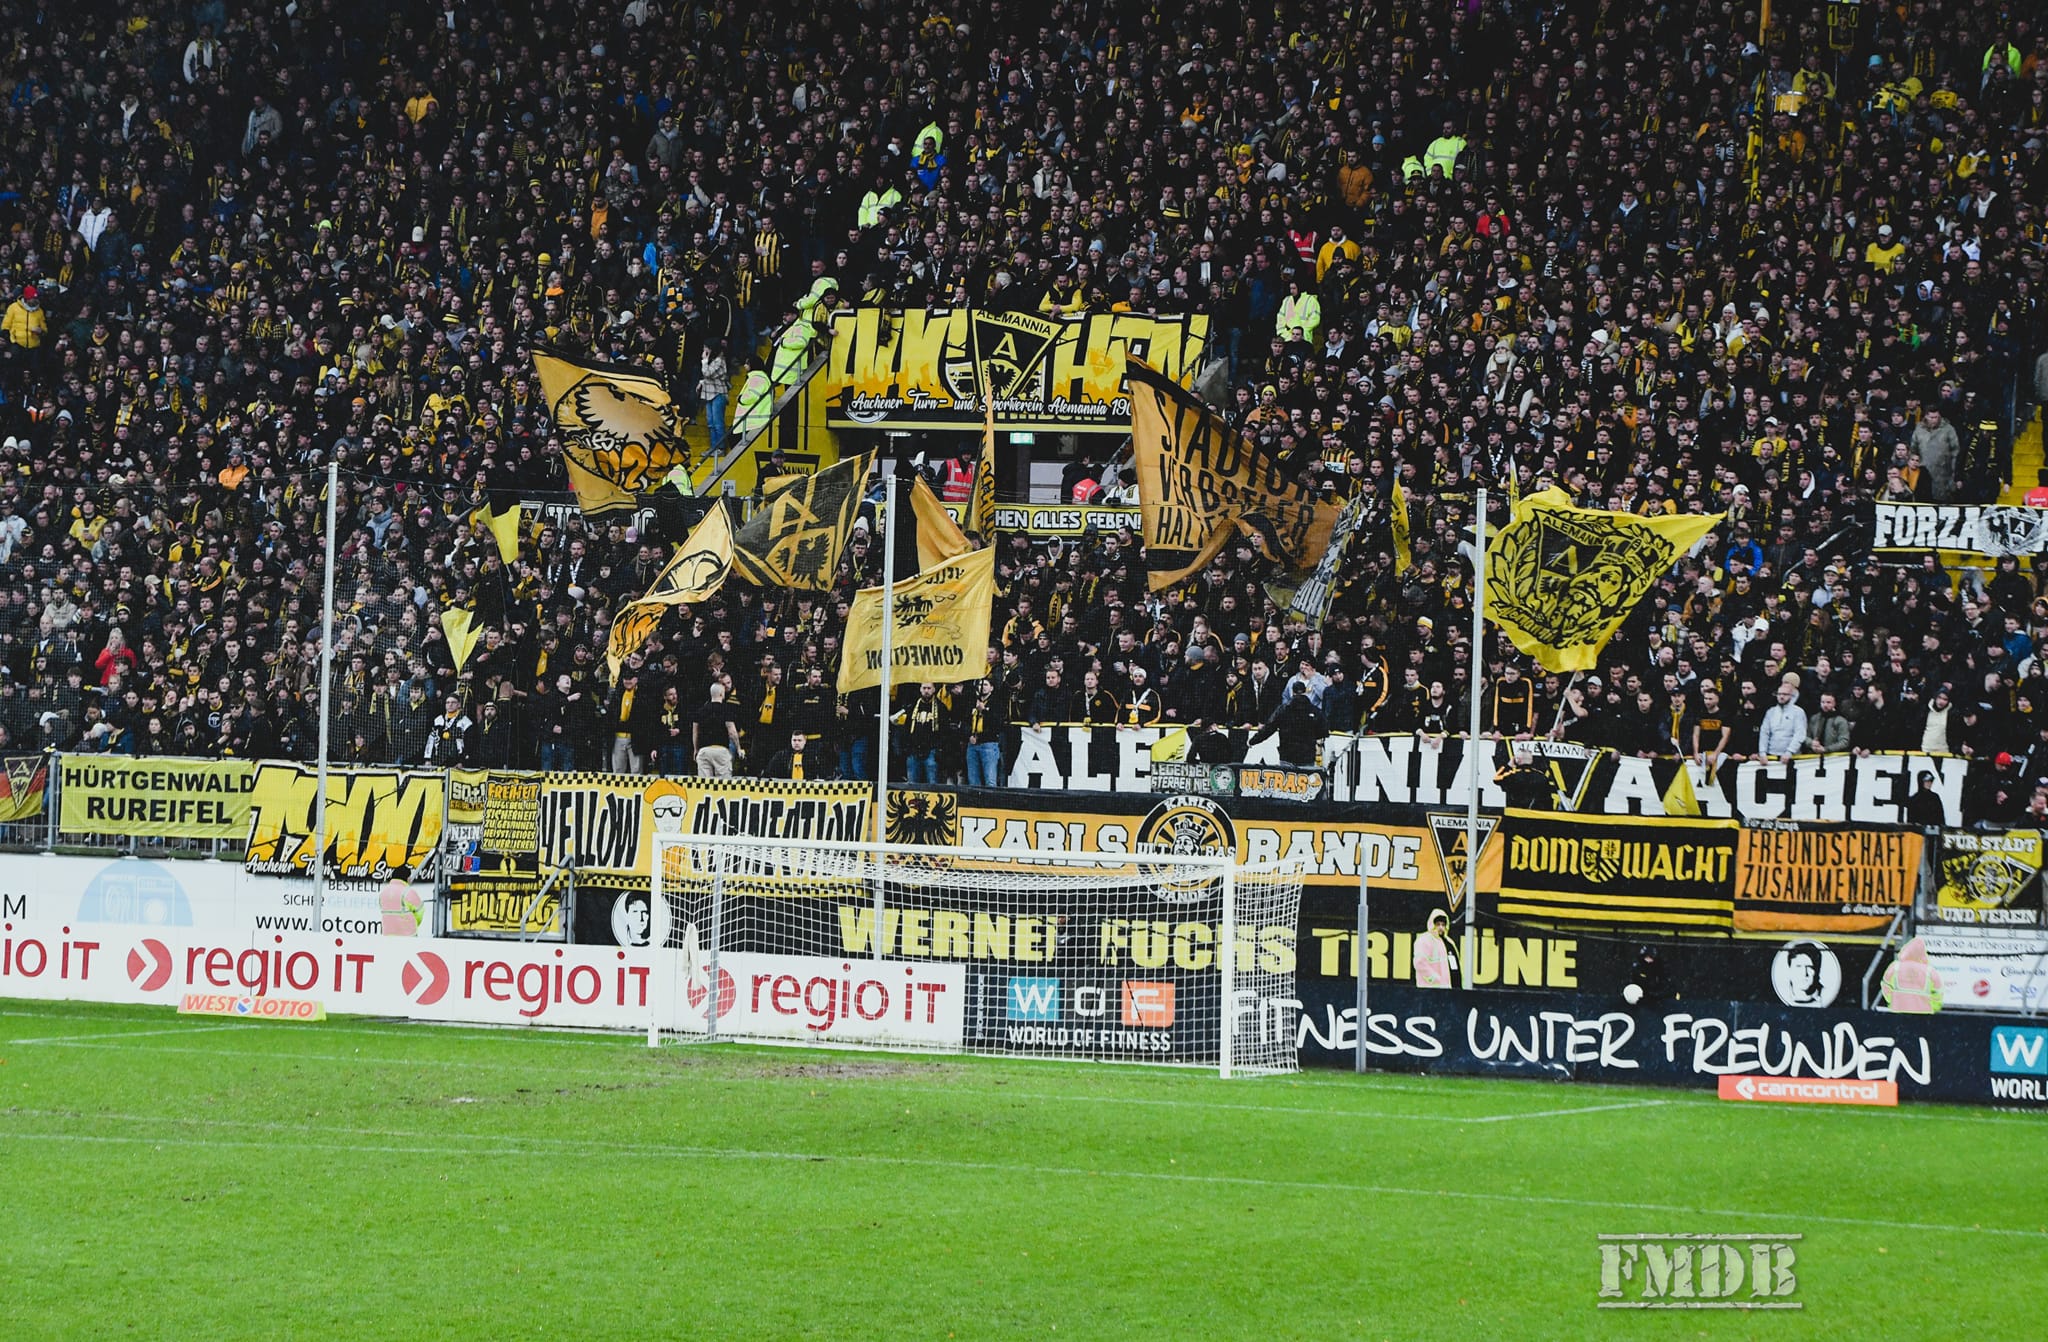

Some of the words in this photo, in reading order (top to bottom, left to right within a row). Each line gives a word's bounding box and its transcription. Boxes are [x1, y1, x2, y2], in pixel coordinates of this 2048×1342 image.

[977, 308, 1051, 336] ALEMANNIA
[993, 332, 1018, 361] A
[851, 391, 903, 410] Aachener
[908, 390, 947, 412] Turn-
[953, 395, 975, 410] und
[1047, 395, 1107, 415] Alemannia
[1033, 511, 1081, 530] ALLES
[1873, 504, 1981, 552] FORZA
[65, 765, 253, 796] HÜRTGENWALD
[1151, 764, 1210, 778] LEGENDEN
[1240, 769, 1309, 793] ULTRAS
[488, 783, 537, 800] FREIHEIT
[1164, 795, 1217, 815] KARLS
[87, 796, 233, 825] RUREIFEL
[485, 809, 537, 821] SICHERHEIT
[451, 825, 480, 840] NEIN
[541, 791, 641, 868] YELLOW
[1943, 829, 1978, 850] FÜR
[1980, 835, 2037, 853] STADT
[958, 816, 1130, 869] KARLS
[1244, 826, 1421, 881] BANDE
[1510, 835, 1578, 874] DOM
[1622, 842, 1732, 883] WACHT
[1749, 830, 1905, 867] FREUNDSCHAFT
[246, 855, 296, 875] Aachener
[348, 860, 369, 878] und
[1742, 864, 1906, 903] ZUSAMMENHALT
[461, 890, 553, 924] HALTUNG
[1941, 906, 1975, 923] UND
[1977, 908, 2038, 925] VEREIN
[255, 915, 383, 934] www.otcom
[186, 934, 320, 997] regio
[1100, 919, 1297, 974] FUCHS
[1312, 927, 1578, 988] TRIÜNE
[464, 948, 602, 1018] regio
[751, 963, 889, 1032] regio
[1008, 1025, 1068, 1047] WORLD
[1073, 1031, 1095, 1048] OF
[1100, 1032, 1171, 1052] FITNESS
[1230, 988, 1444, 1058] FITNESS
[1466, 1007, 1640, 1069] UNTER
[1661, 1013, 1931, 1086] FREUNDEN
[1758, 1083, 1878, 1100] camcontrol
[1990, 1077, 2048, 1101] WORL
